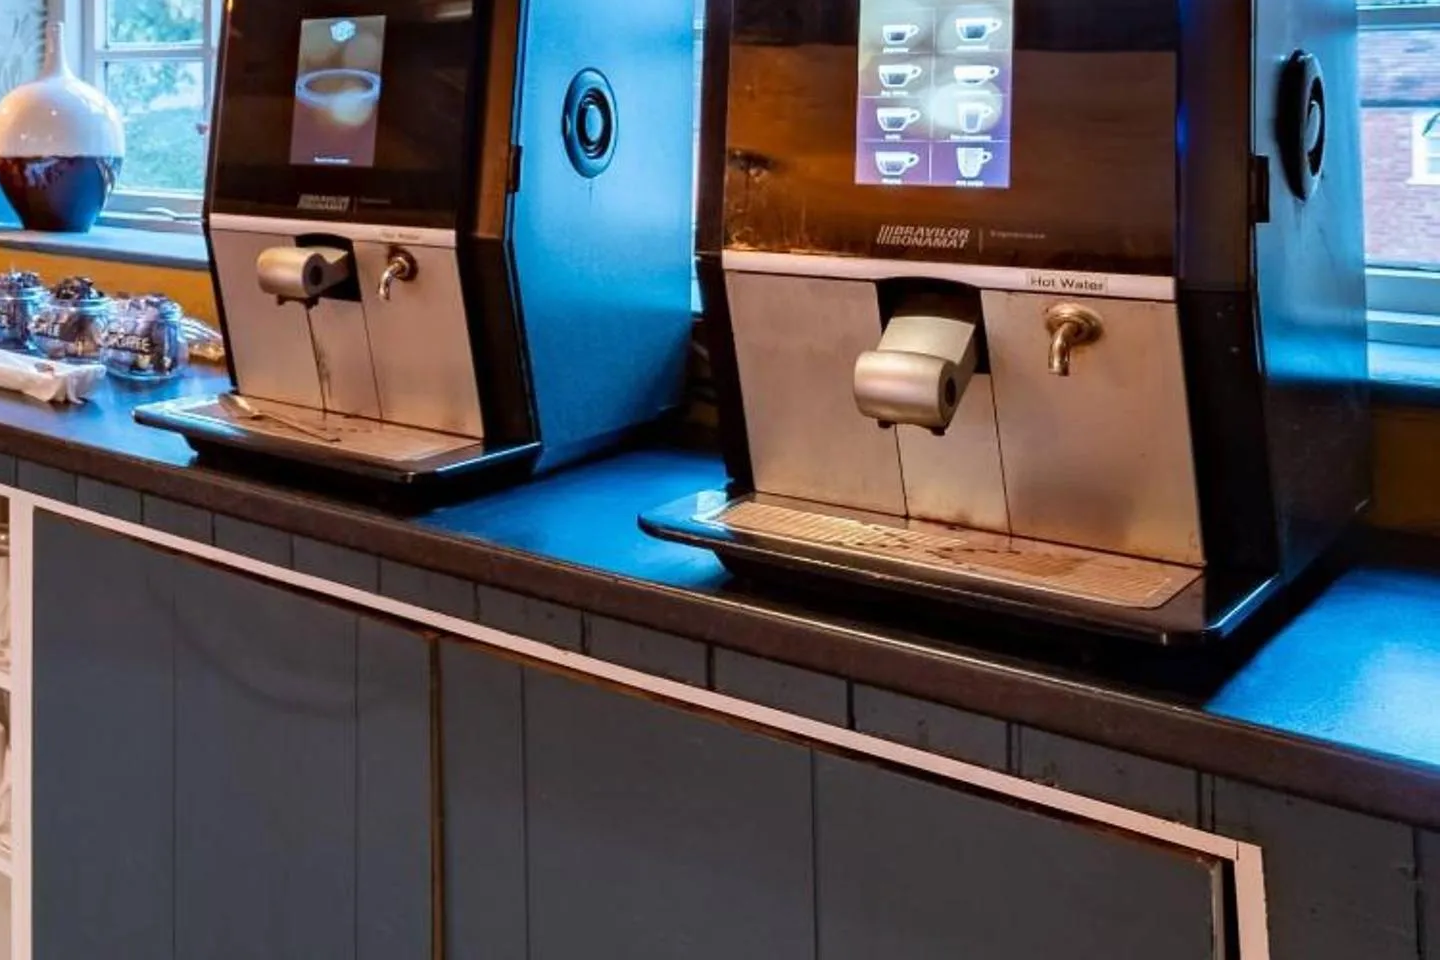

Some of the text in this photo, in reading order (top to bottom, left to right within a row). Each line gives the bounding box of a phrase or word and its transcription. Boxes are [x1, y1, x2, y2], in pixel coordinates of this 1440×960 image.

[893, 225, 971, 240] BRAVILOR
[891, 235, 968, 249] BONAMAT
[1030, 276, 1104, 291] Hot Water
